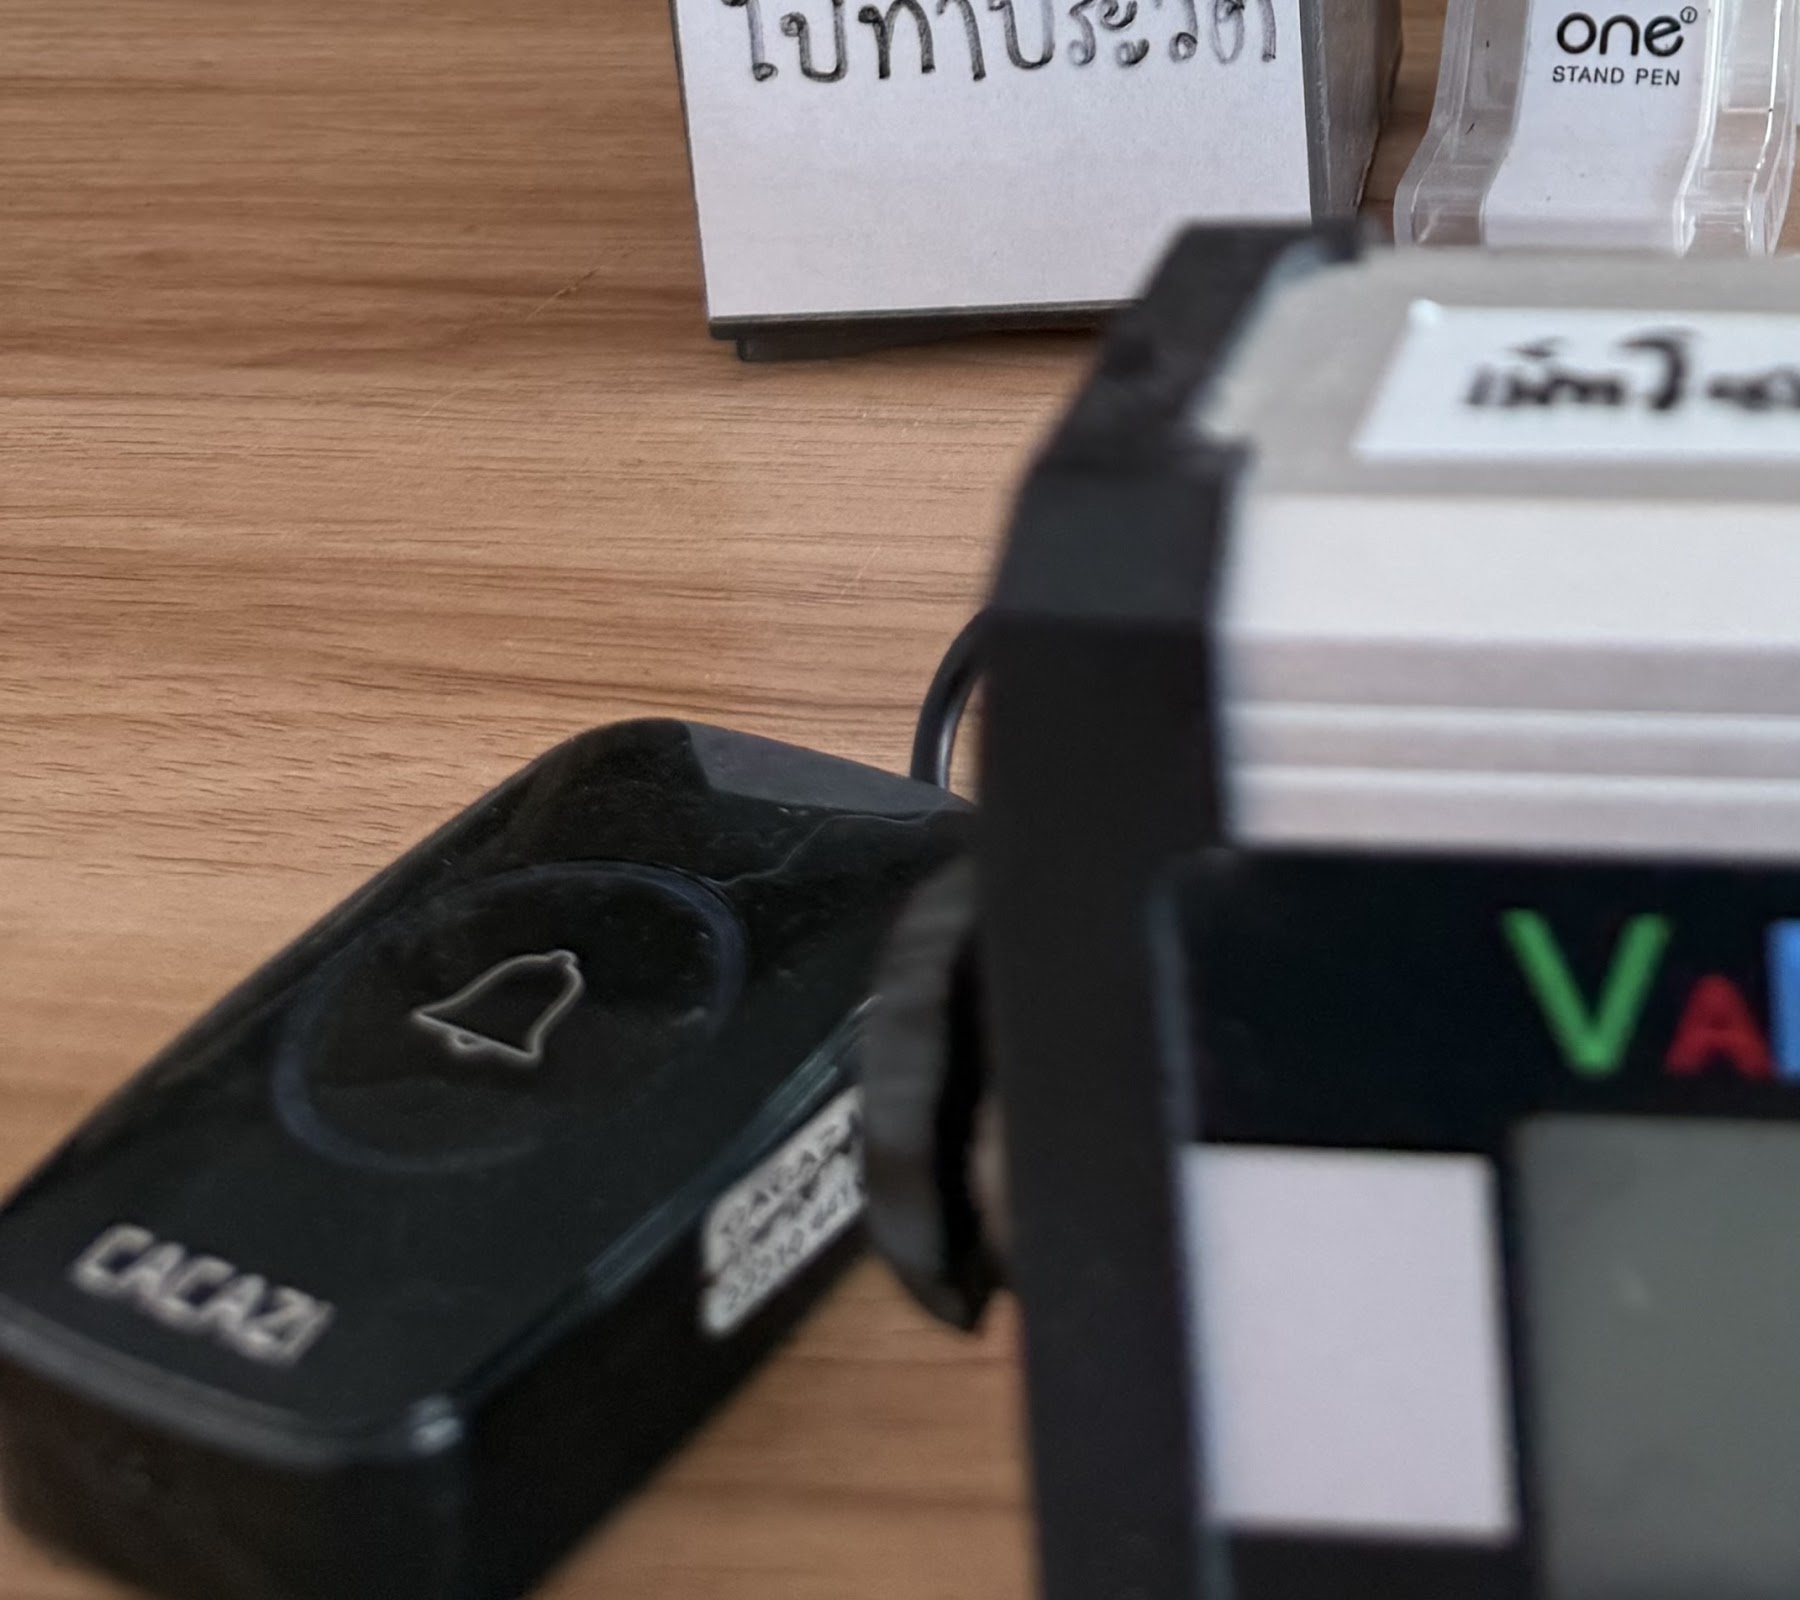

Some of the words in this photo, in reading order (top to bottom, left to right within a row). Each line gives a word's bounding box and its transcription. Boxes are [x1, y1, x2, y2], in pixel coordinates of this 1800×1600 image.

[1552, 65, 1625, 85] STAND
[1635, 67, 1681, 87] PEN
[71, 1222, 337, 1367] CACAZI
